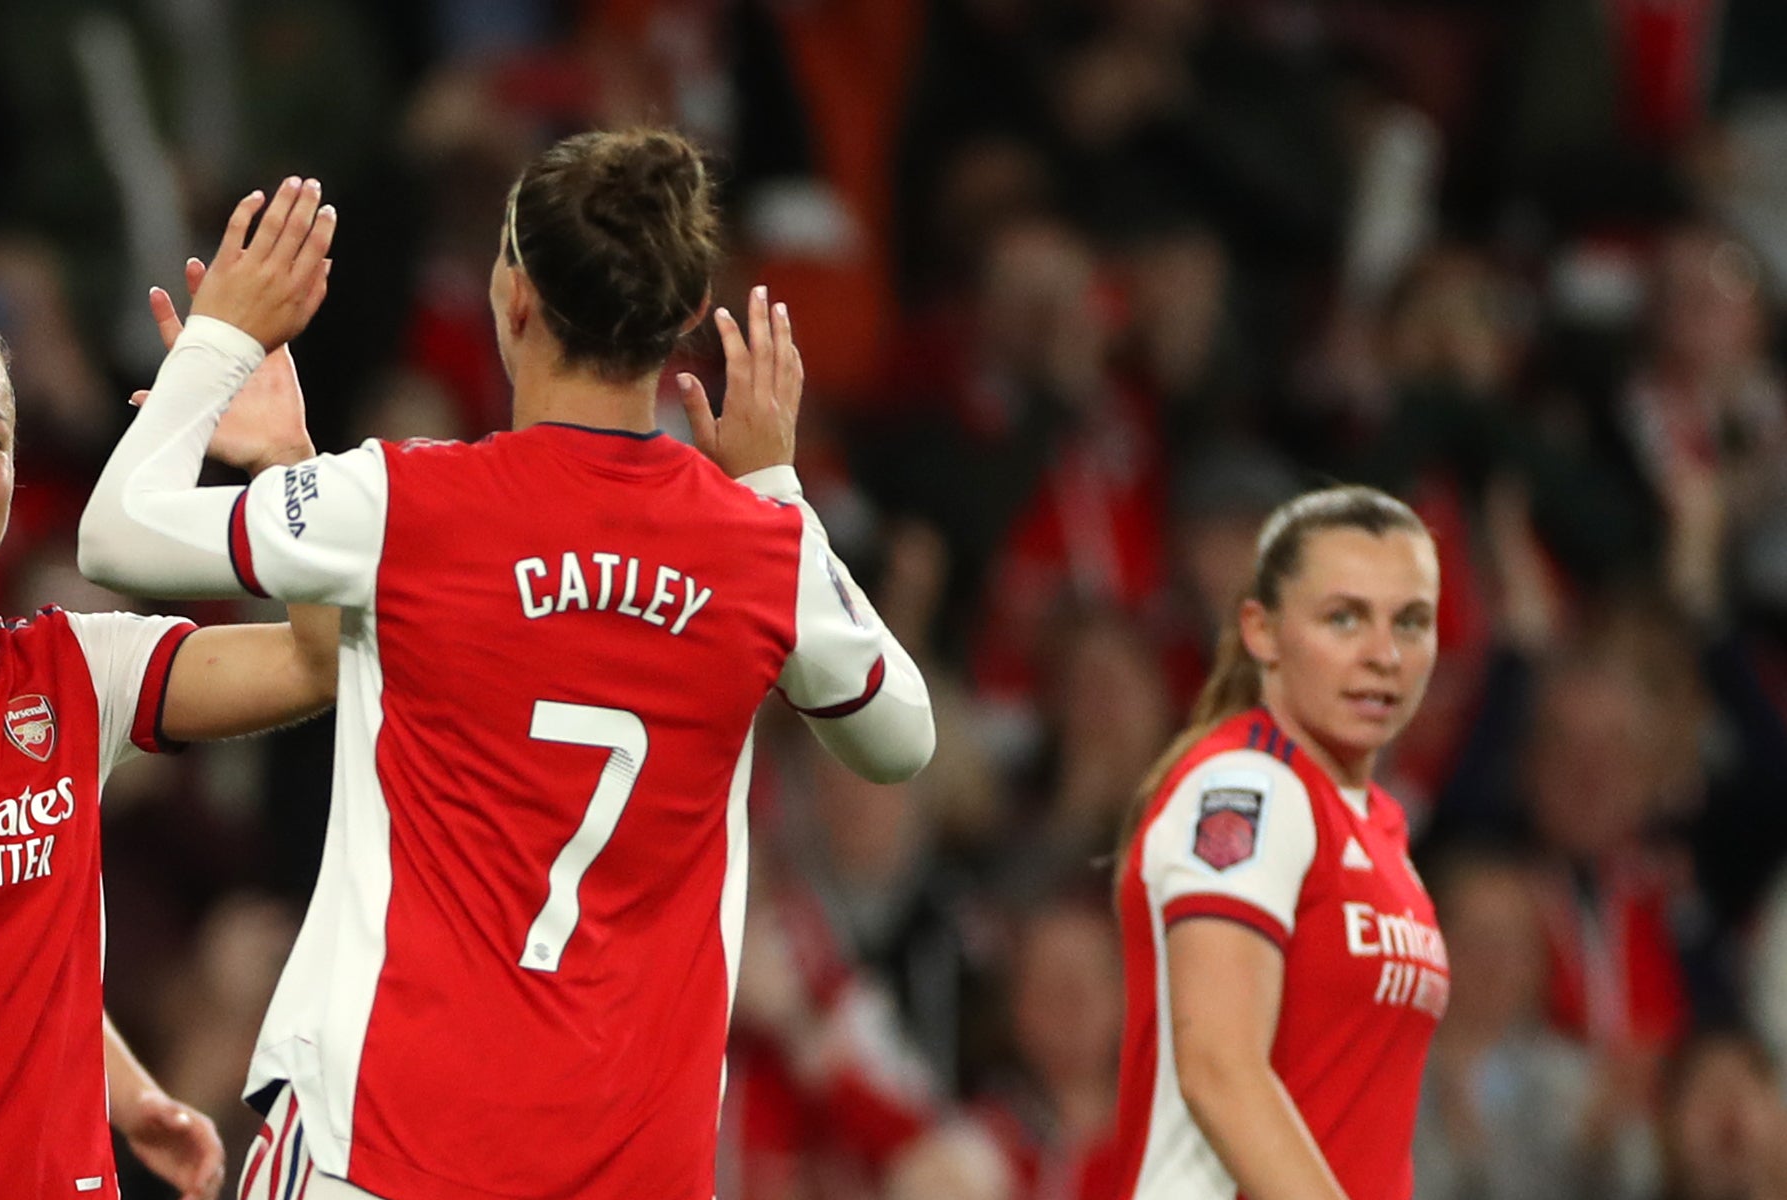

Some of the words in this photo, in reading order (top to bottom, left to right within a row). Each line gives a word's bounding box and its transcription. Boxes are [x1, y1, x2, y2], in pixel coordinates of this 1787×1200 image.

[514, 551, 712, 636] CATLEY
[6, 703, 48, 722] Arsenal
[517, 699, 649, 973] 7
